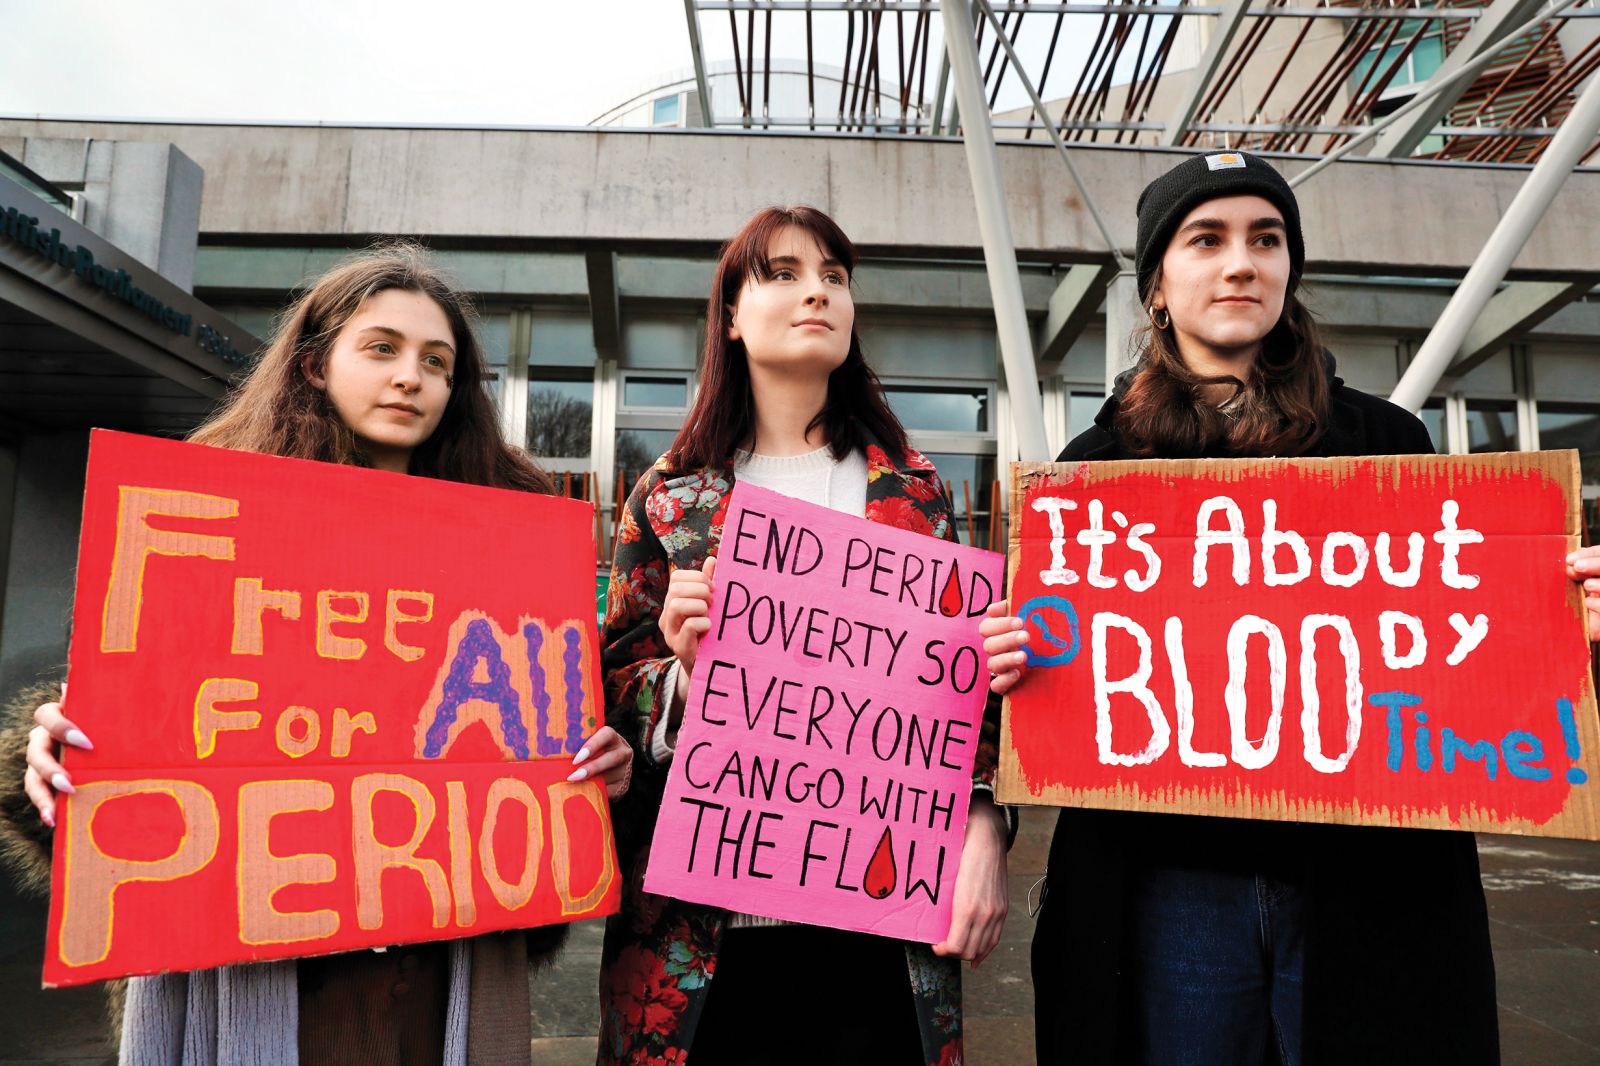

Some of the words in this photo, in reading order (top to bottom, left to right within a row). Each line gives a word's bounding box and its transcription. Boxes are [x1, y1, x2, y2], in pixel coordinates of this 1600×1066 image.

[0, 205, 69, 268] ttish
[732, 508, 823, 576] END
[1031, 496, 1161, 593] It's
[1193, 495, 1485, 589] About
[717, 581, 908, 677] POVERTY
[917, 640, 979, 694] SO
[701, 660, 973, 770] EVERYONE
[1368, 690, 1588, 785] Time!
[680, 797, 784, 880] THE
[860, 776, 956, 832] WITH
[58, 773, 615, 967] PERIOD
